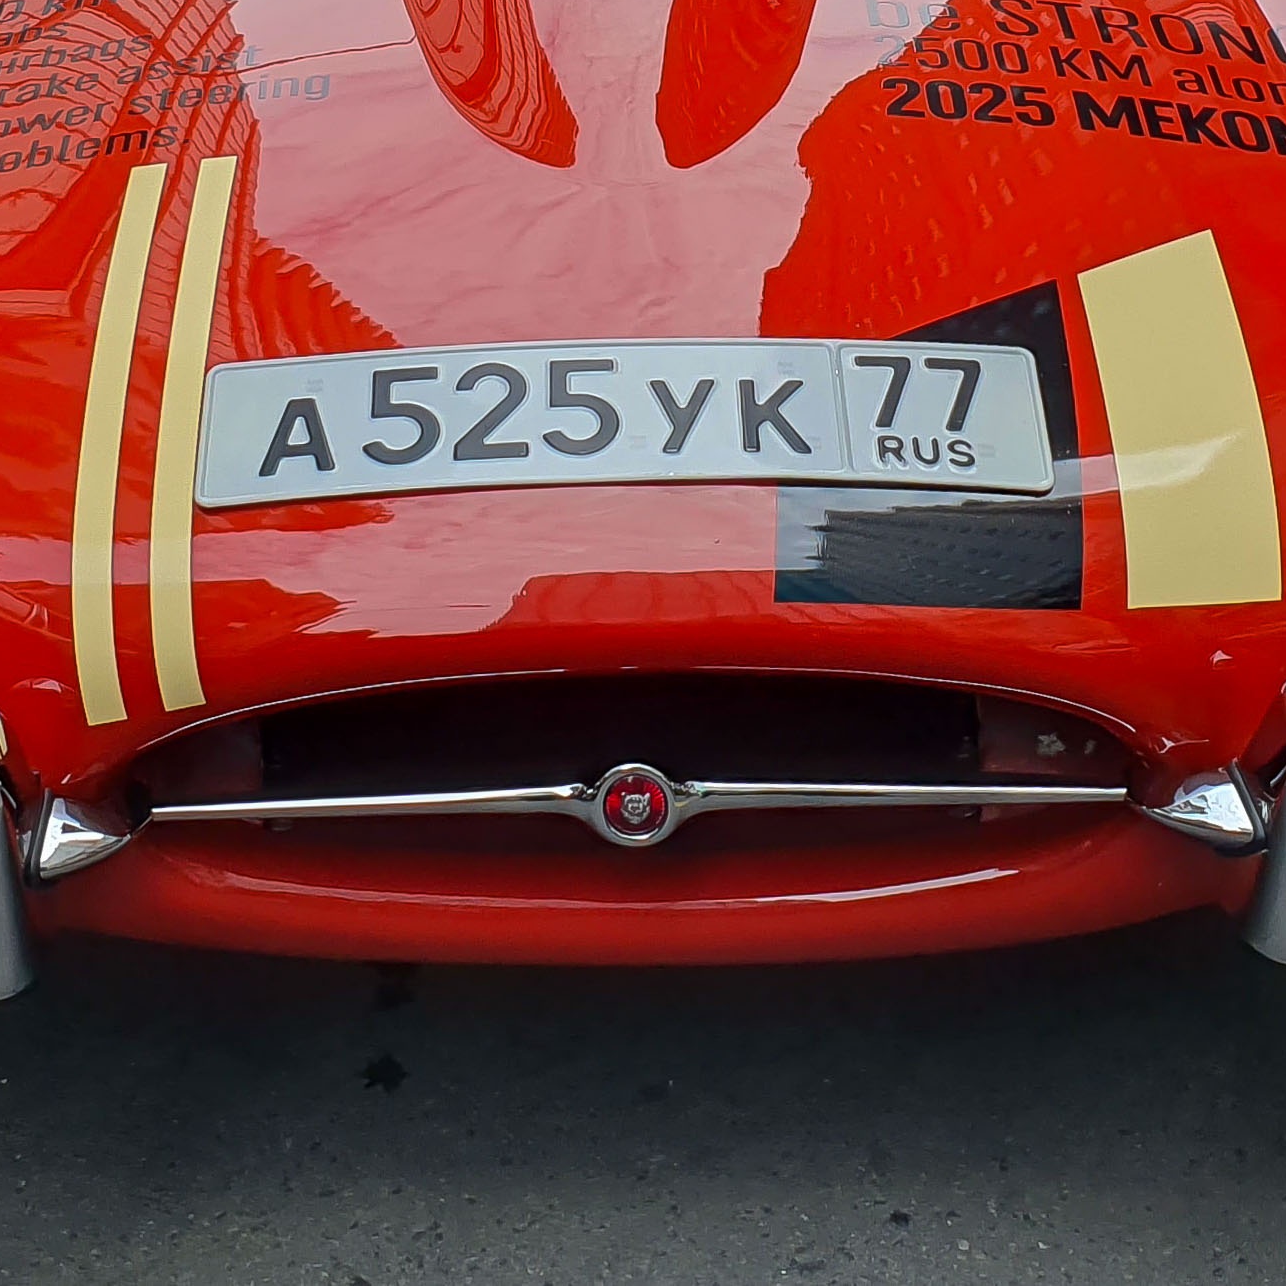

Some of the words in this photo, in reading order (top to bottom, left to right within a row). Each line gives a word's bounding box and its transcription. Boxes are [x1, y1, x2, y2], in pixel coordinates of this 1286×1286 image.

[117, 44, 265, 85] assist
[874, 34, 1031, 75] 2500
[1049, 45, 1153, 89] KM
[128, 73, 332, 116] steering
[881, 77, 1056, 127] 2025
[877, 435, 978, 468] RUS
